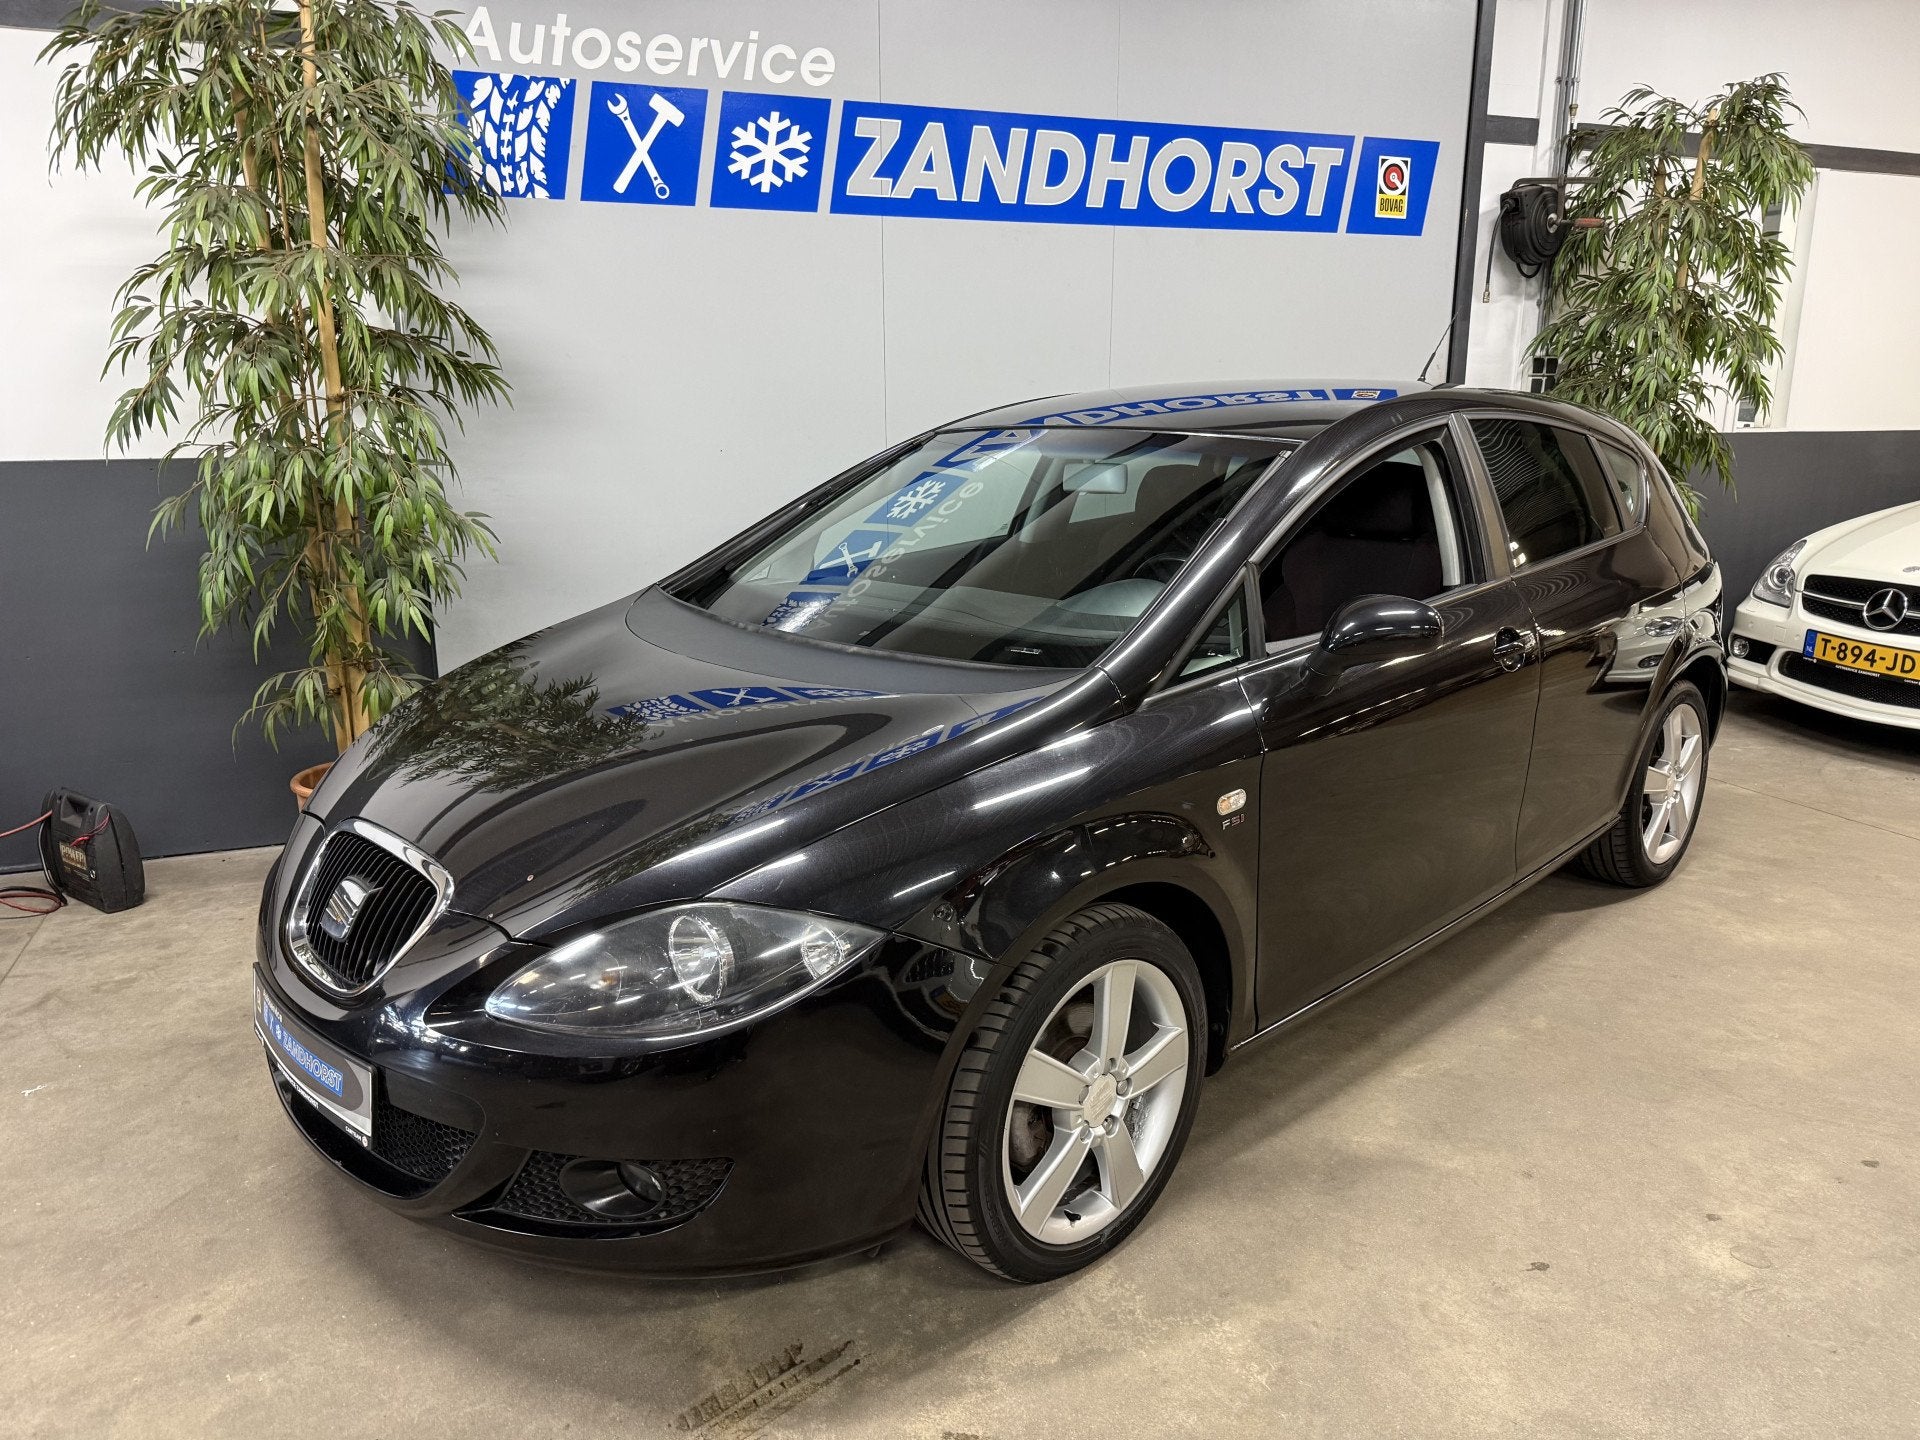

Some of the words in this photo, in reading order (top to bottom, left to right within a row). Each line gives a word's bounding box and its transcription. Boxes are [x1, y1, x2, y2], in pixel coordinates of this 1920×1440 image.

[453, 5, 837, 88] Autoservice
[846, 116, 1344, 216] ZANDHORST
[1379, 197, 1404, 213] BOVAG
[1821, 637, 1917, 675] T-894-JD
[282, 1030, 342, 1092] ZANDHORST
